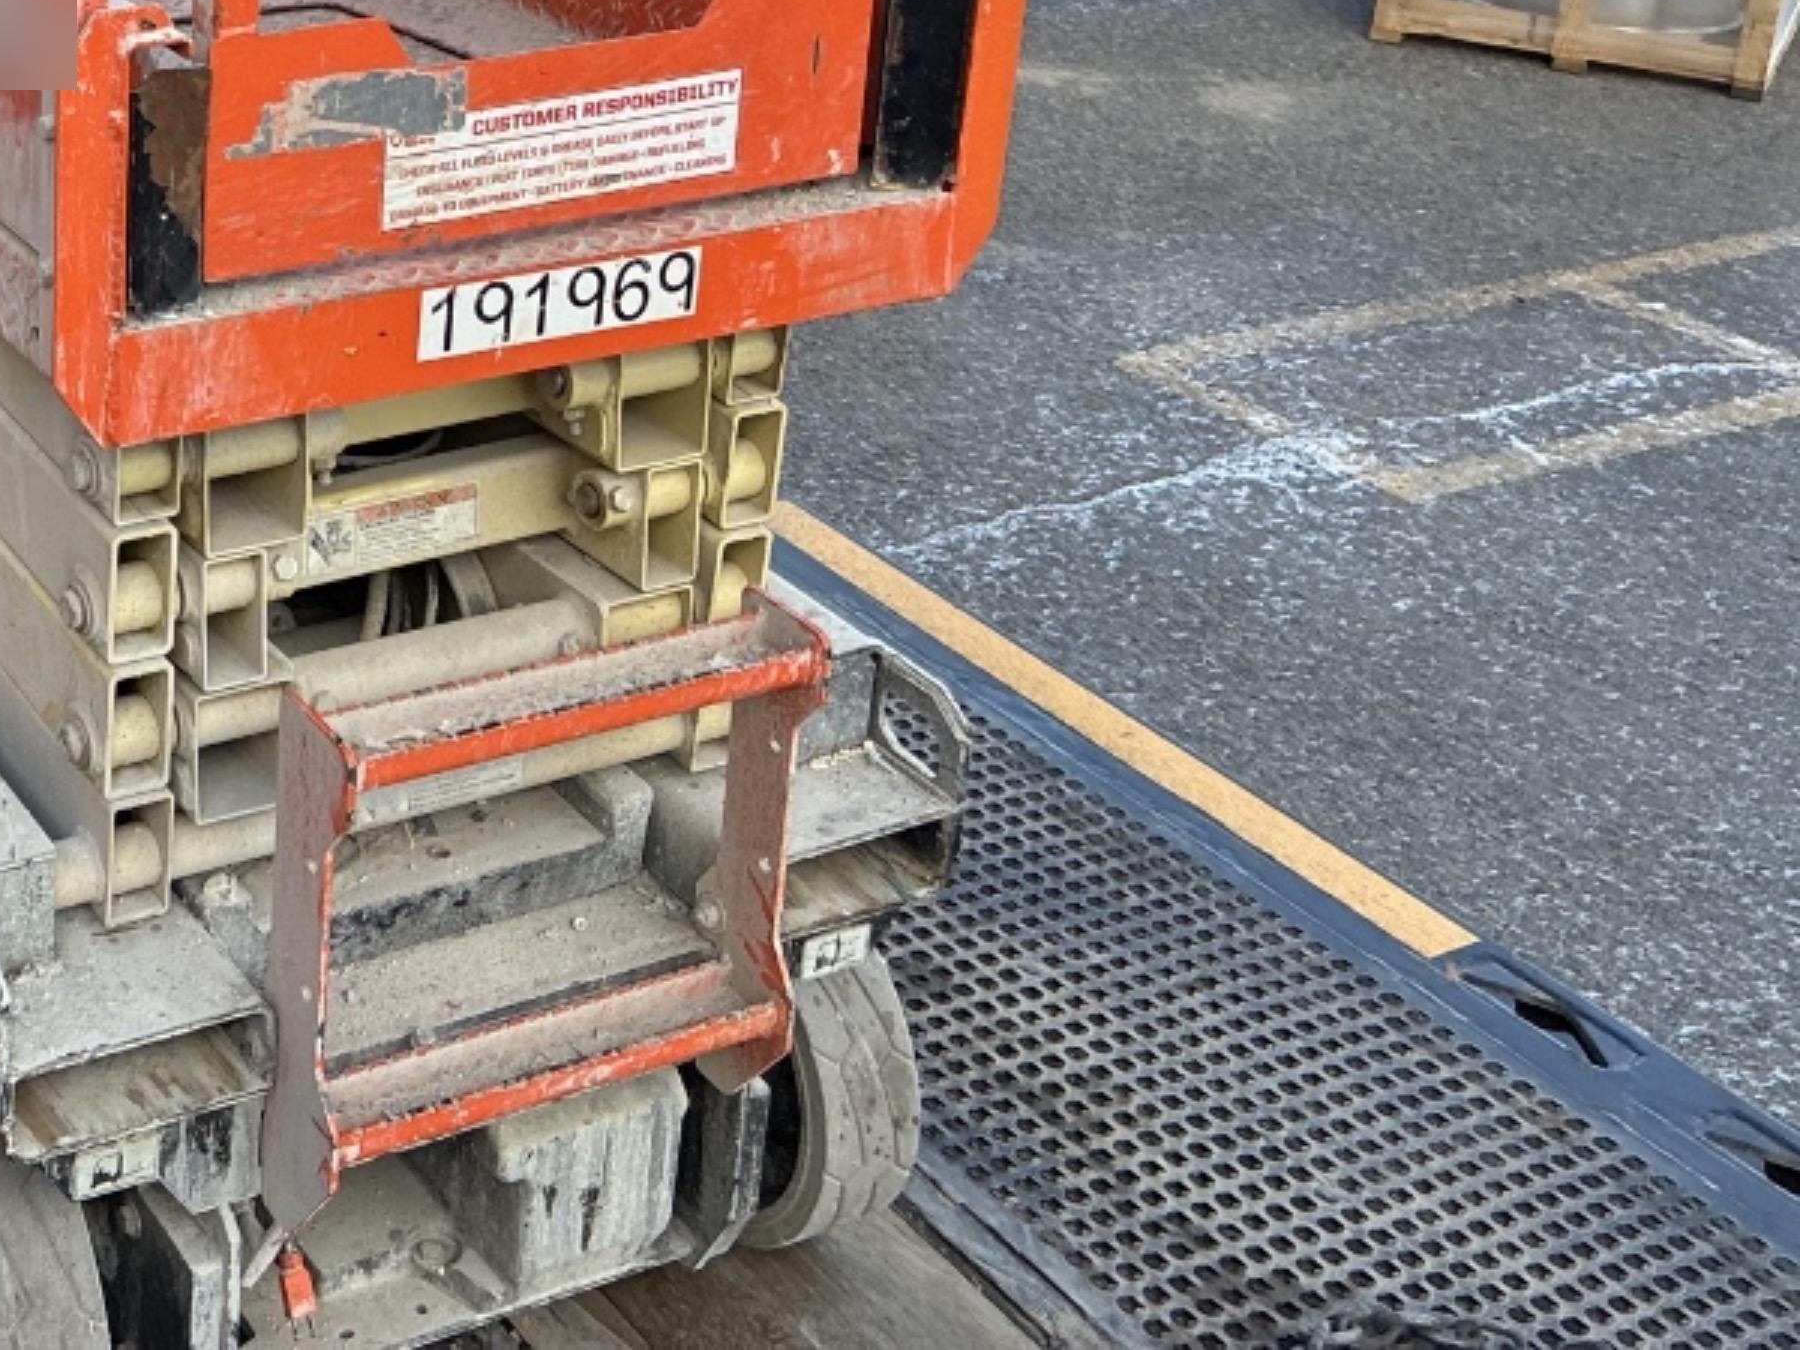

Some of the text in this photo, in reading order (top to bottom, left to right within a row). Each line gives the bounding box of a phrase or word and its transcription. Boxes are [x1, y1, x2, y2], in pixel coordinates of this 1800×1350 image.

[472, 76, 738, 136] CUSTOMER RESPONSIBILITY
[429, 251, 698, 352] 191969
